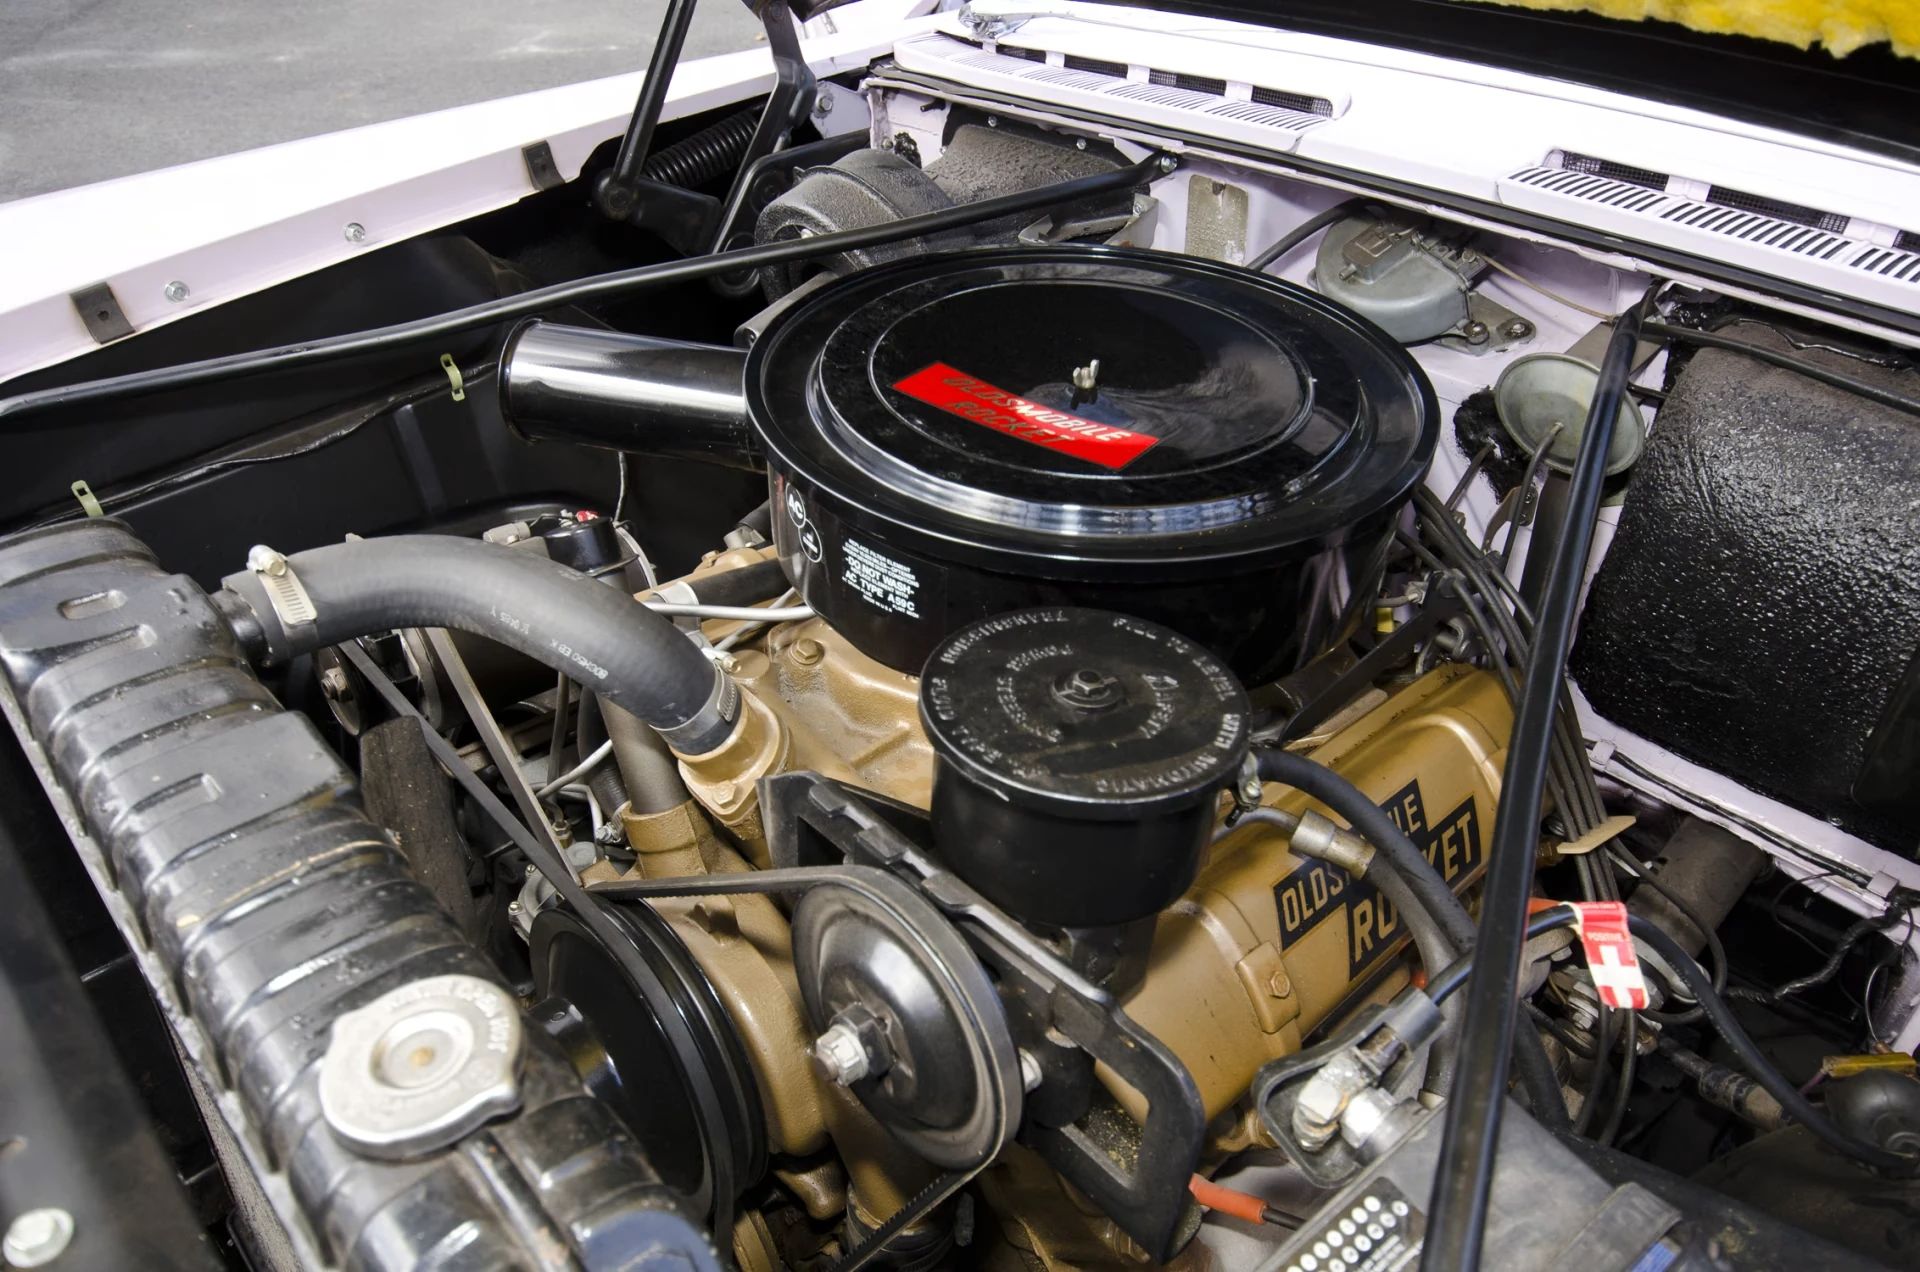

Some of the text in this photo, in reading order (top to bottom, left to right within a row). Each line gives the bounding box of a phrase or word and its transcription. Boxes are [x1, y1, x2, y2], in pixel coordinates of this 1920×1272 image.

[943, 376, 1132, 442] OLDSMOBILE
[946, 401, 1075, 443] ROCKET
[788, 493, 804, 519] AC
[845, 570, 857, 583] AC
[860, 578, 884, 598] TYPE
[861, 563, 881, 580] NOT
[940, 610, 1069, 664] TRANSMISSION
[1006, 644, 1073, 671] POWER
[931, 677, 955, 720] FLUID
[1192, 656, 1236, 701] LEVEL
[1214, 713, 1240, 749] WITH
[1096, 753, 1217, 793] AUTOMATIC
